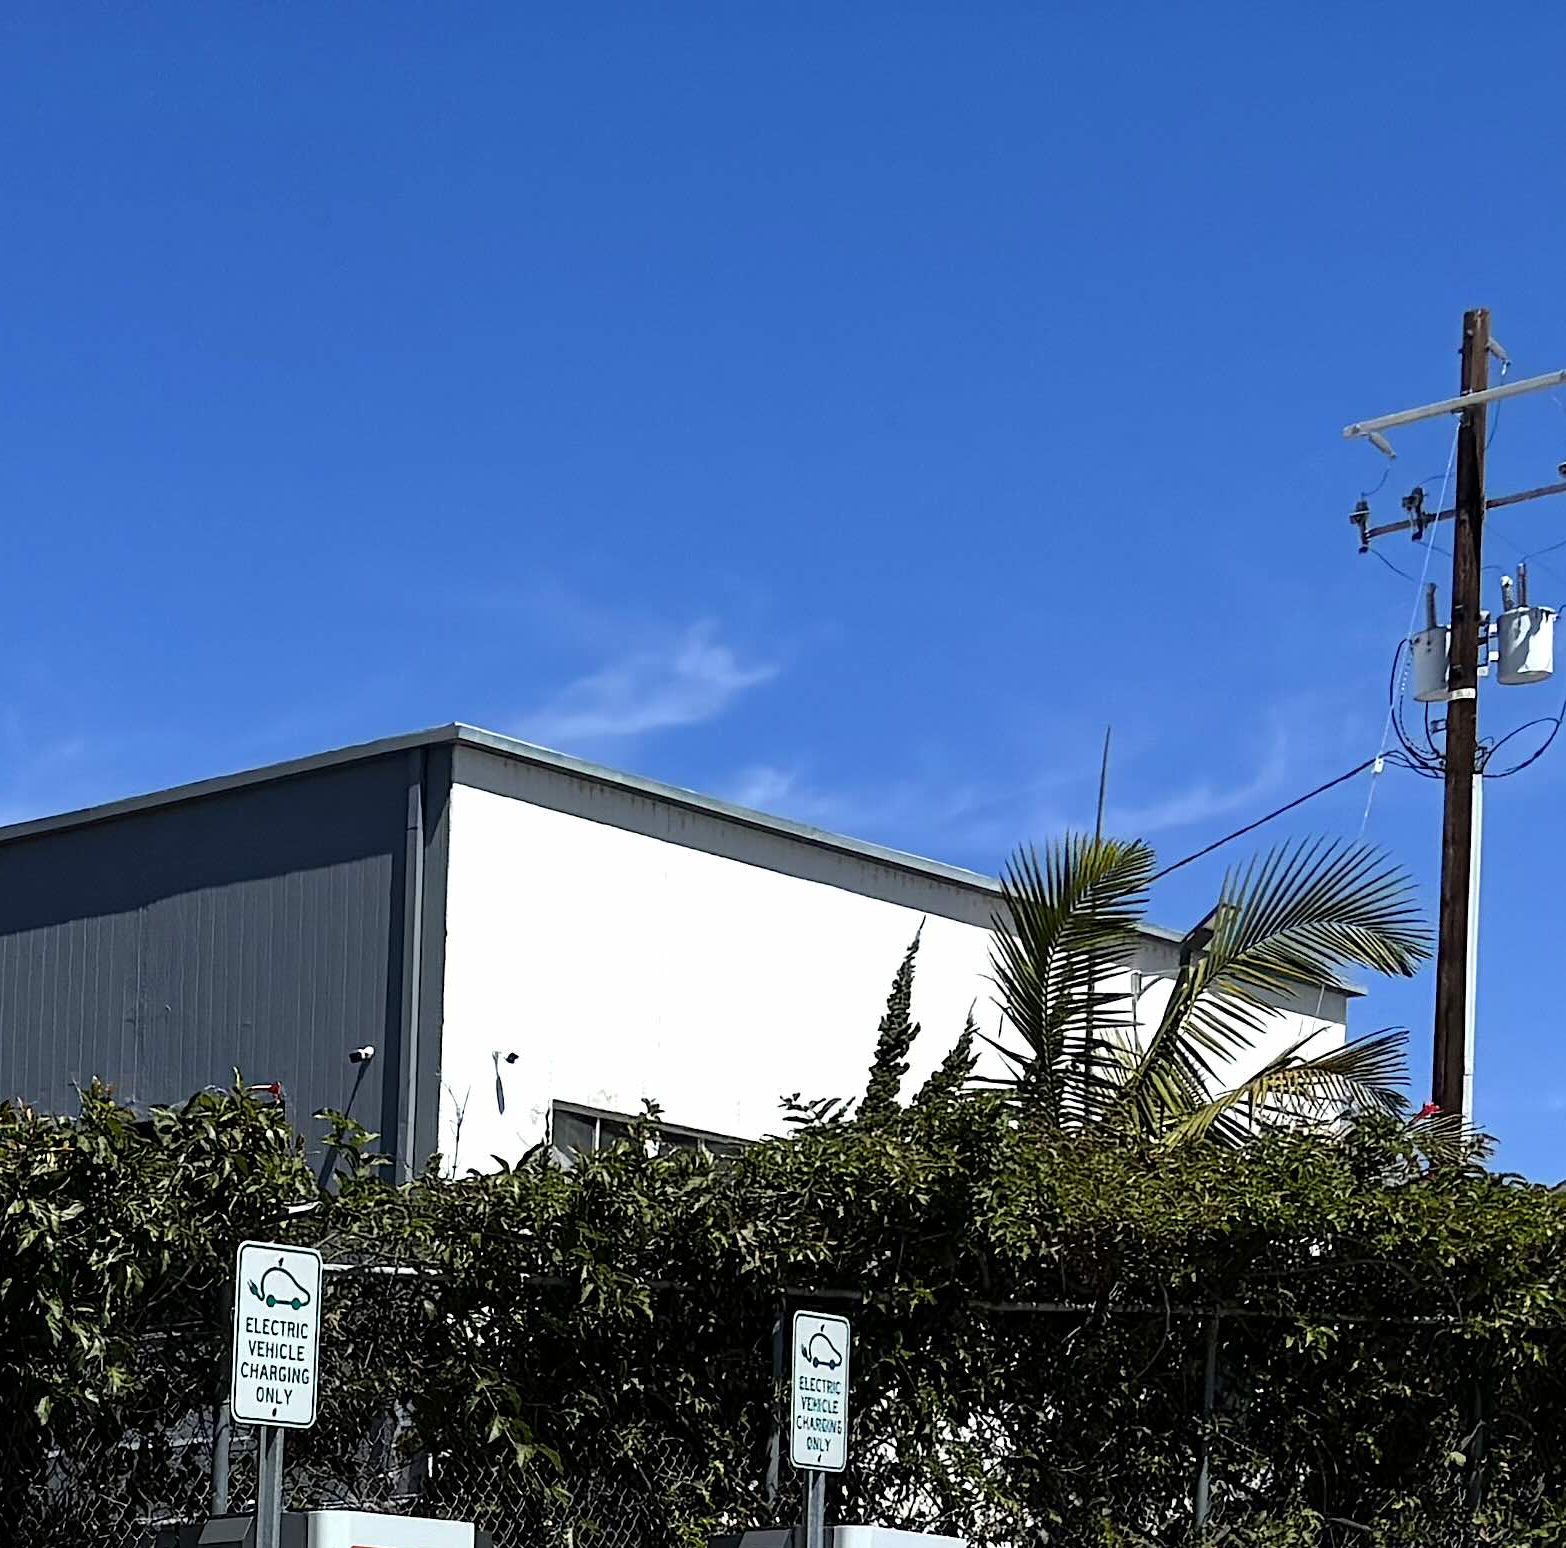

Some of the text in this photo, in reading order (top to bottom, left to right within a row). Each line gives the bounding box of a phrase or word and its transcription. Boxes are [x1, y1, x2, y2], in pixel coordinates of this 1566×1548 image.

[246, 1317, 308, 1339] ELECTRIC
[248, 1340, 305, 1361] VEHICLE
[241, 1362, 309, 1384] CHARGING
[799, 1375, 841, 1395] ELECTRIC
[256, 1386, 293, 1406] ONLY
[801, 1396, 838, 1414] VEHICLE
[797, 1415, 842, 1434] CHARGING
[806, 1436, 831, 1452] ONLY
